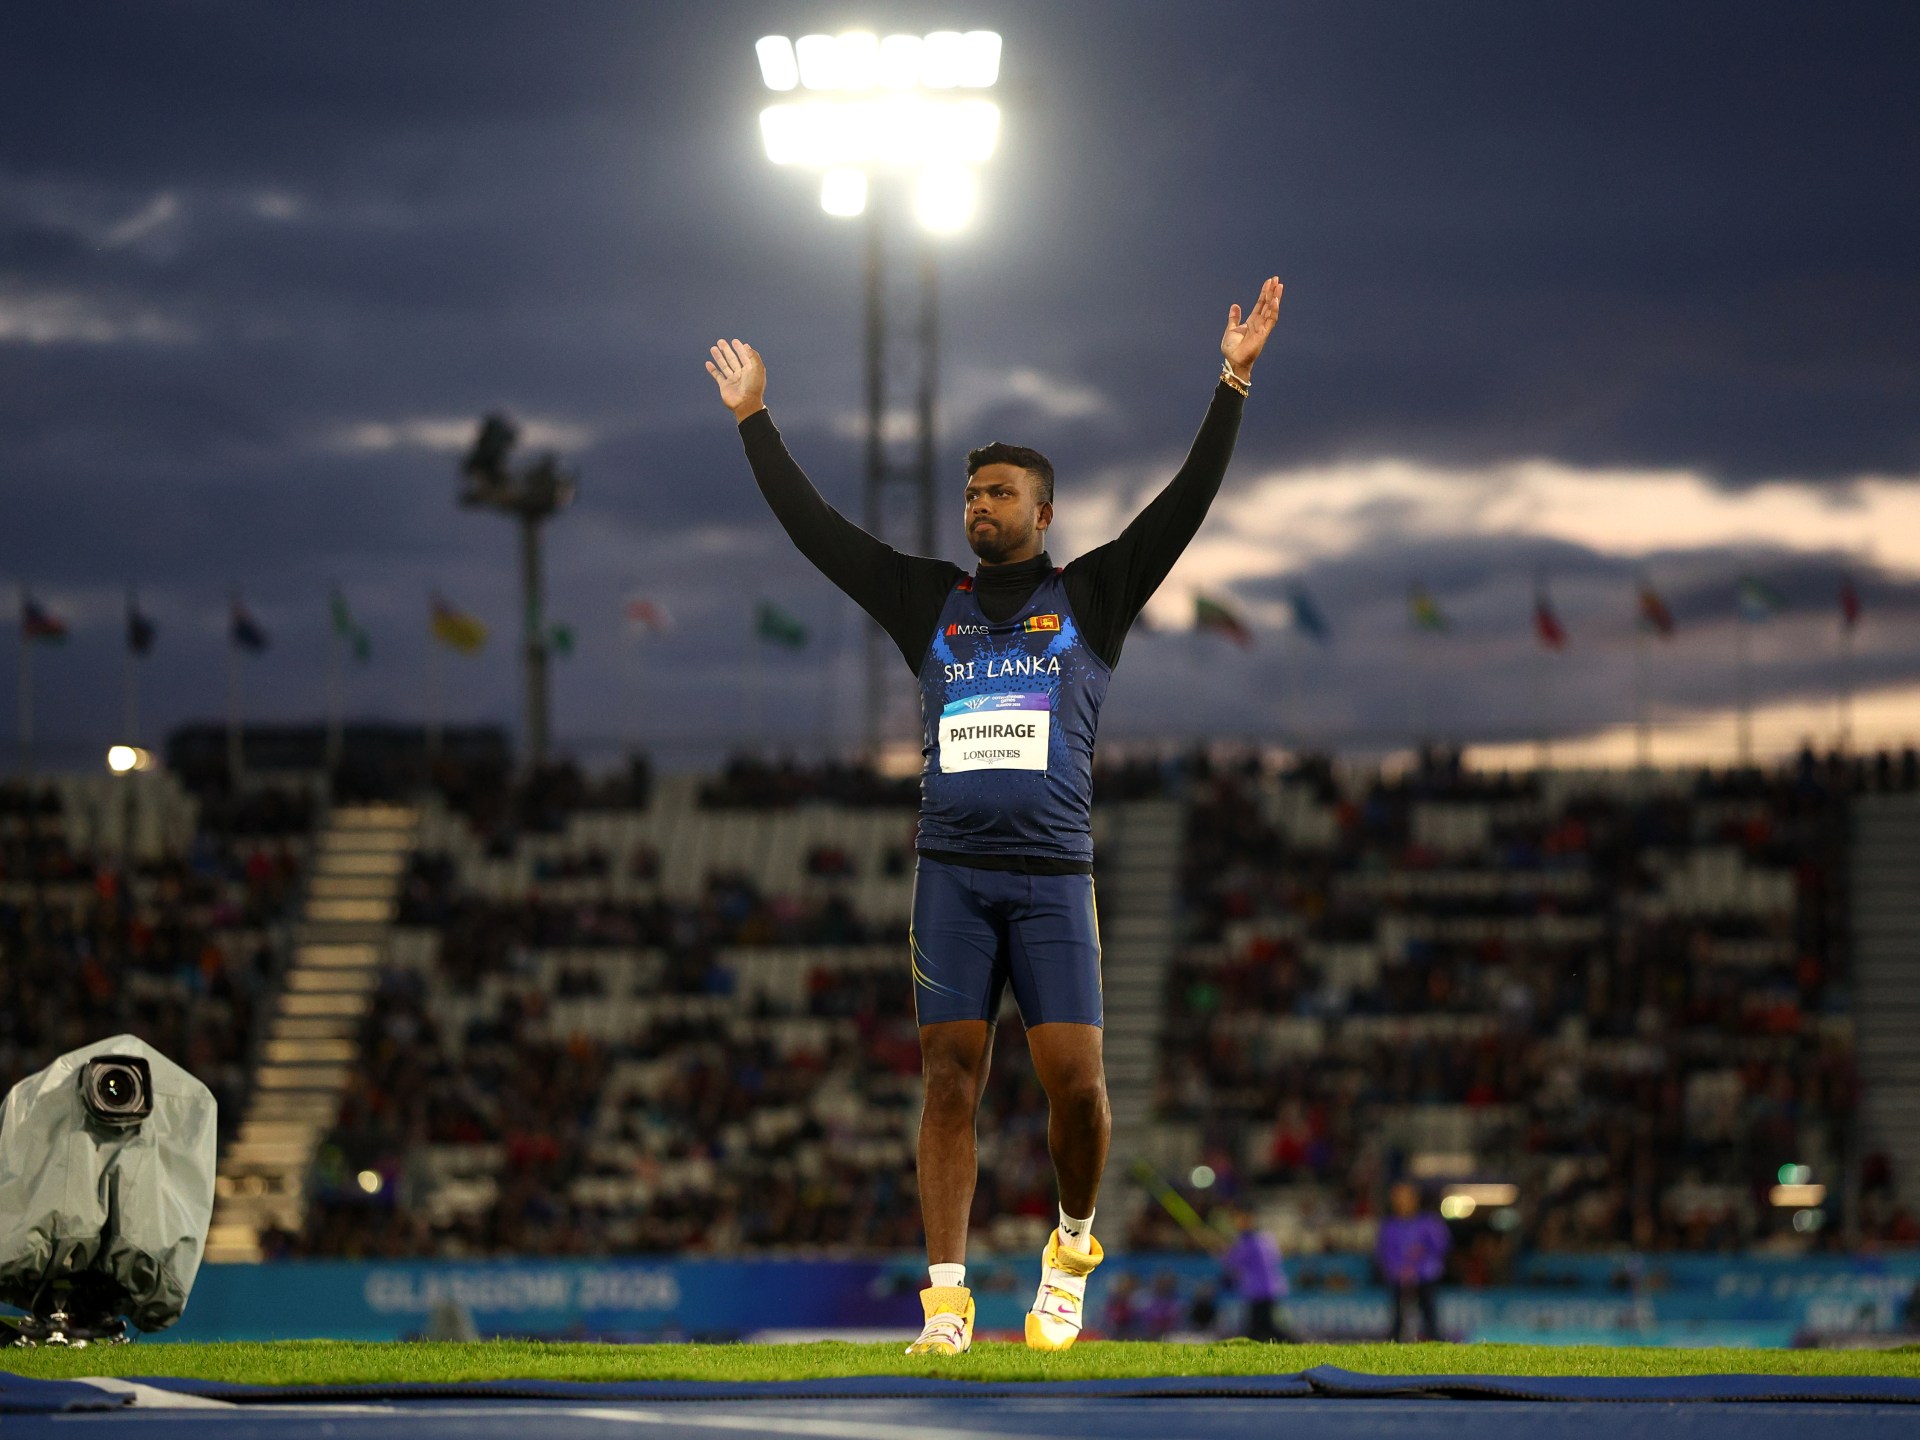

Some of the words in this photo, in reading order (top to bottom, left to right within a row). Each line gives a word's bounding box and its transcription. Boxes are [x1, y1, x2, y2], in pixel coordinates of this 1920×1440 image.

[957, 625, 990, 635] MAS
[944, 661, 975, 683] SRI
[987, 655, 1061, 678] LANKA
[950, 723, 1036, 742] PATHIRAGE
[963, 749, 1021, 760] LONGINES
